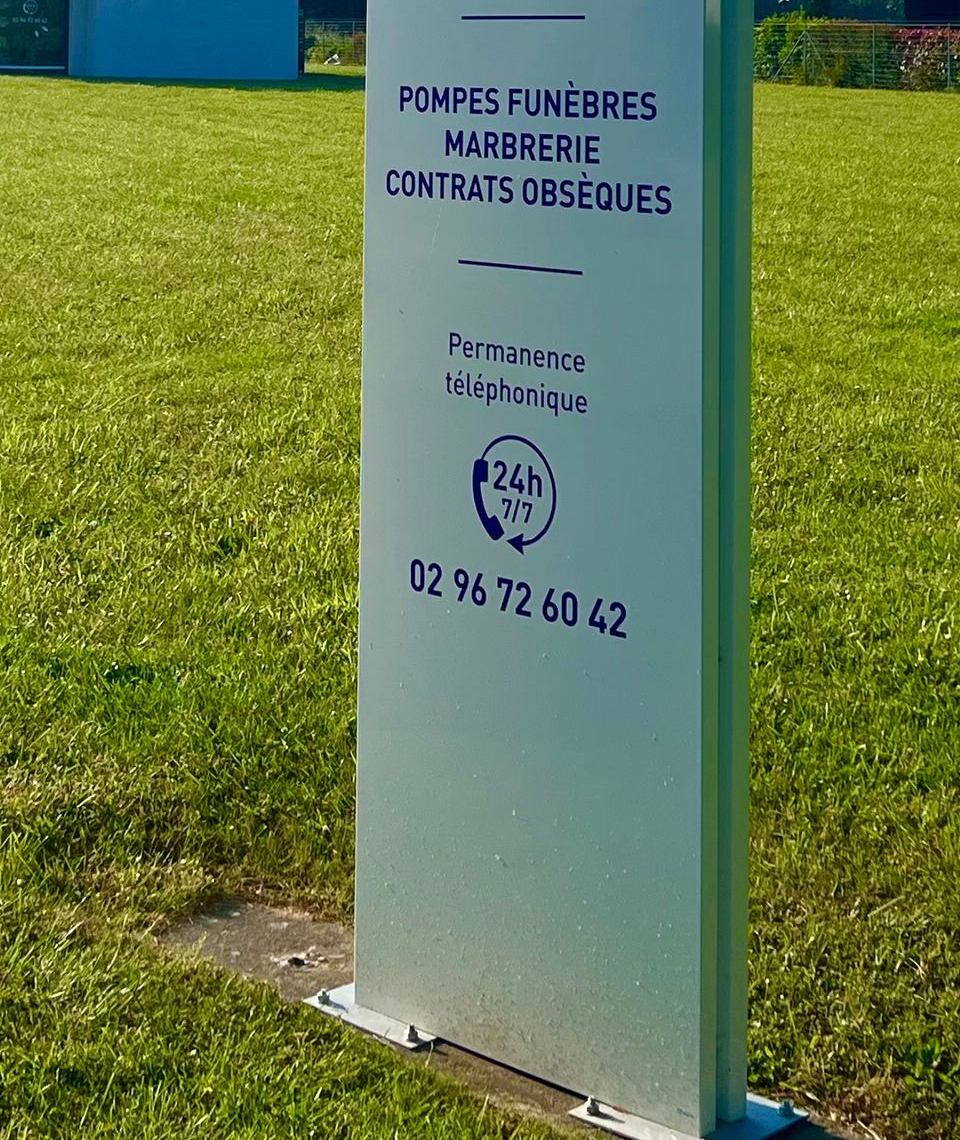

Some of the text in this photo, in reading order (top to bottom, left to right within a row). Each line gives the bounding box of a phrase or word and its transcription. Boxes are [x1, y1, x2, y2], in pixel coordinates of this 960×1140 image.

[399, 80, 658, 121] POMPES FUNÈBRES
[445, 129, 601, 165] MARBRERIE
[386, 169, 672, 215] CONTRATS OBSÈQUES
[448, 332, 586, 373] Permanence
[445, 370, 588, 416] téléphonique
[493, 460, 543, 498] 24h
[501, 497, 533, 524] 7/7
[410, 559, 627, 639] 02 96 72 60 42
